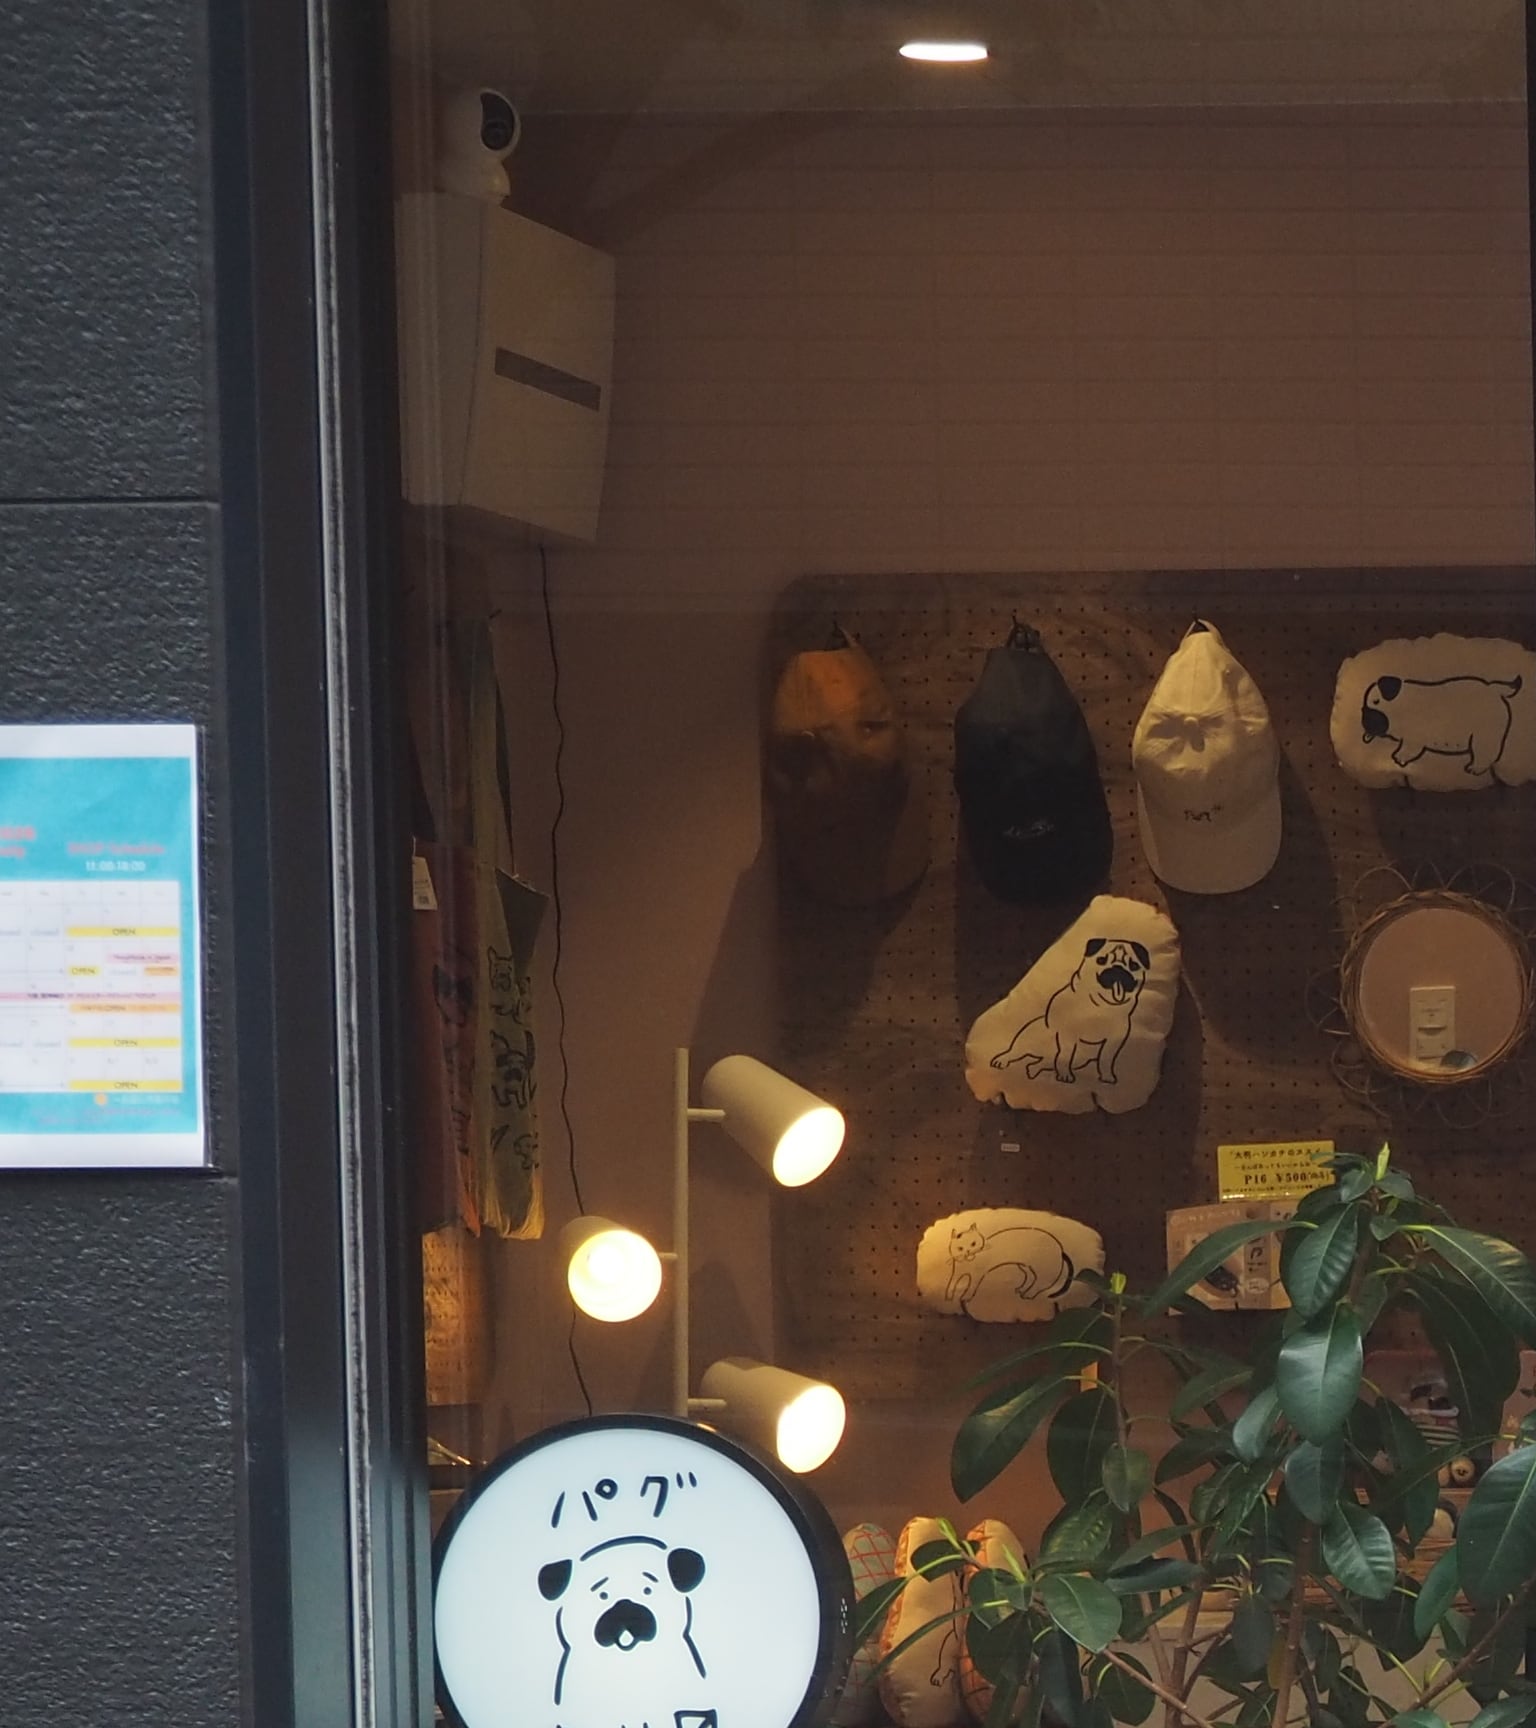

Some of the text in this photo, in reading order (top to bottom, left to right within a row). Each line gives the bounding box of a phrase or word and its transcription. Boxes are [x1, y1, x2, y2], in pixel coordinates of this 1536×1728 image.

[71, 967, 96, 976] OPEN
[114, 1039, 139, 1047] OPEN
[114, 1081, 139, 1090] OPEN
[551, 1472, 698, 1529] パグ
